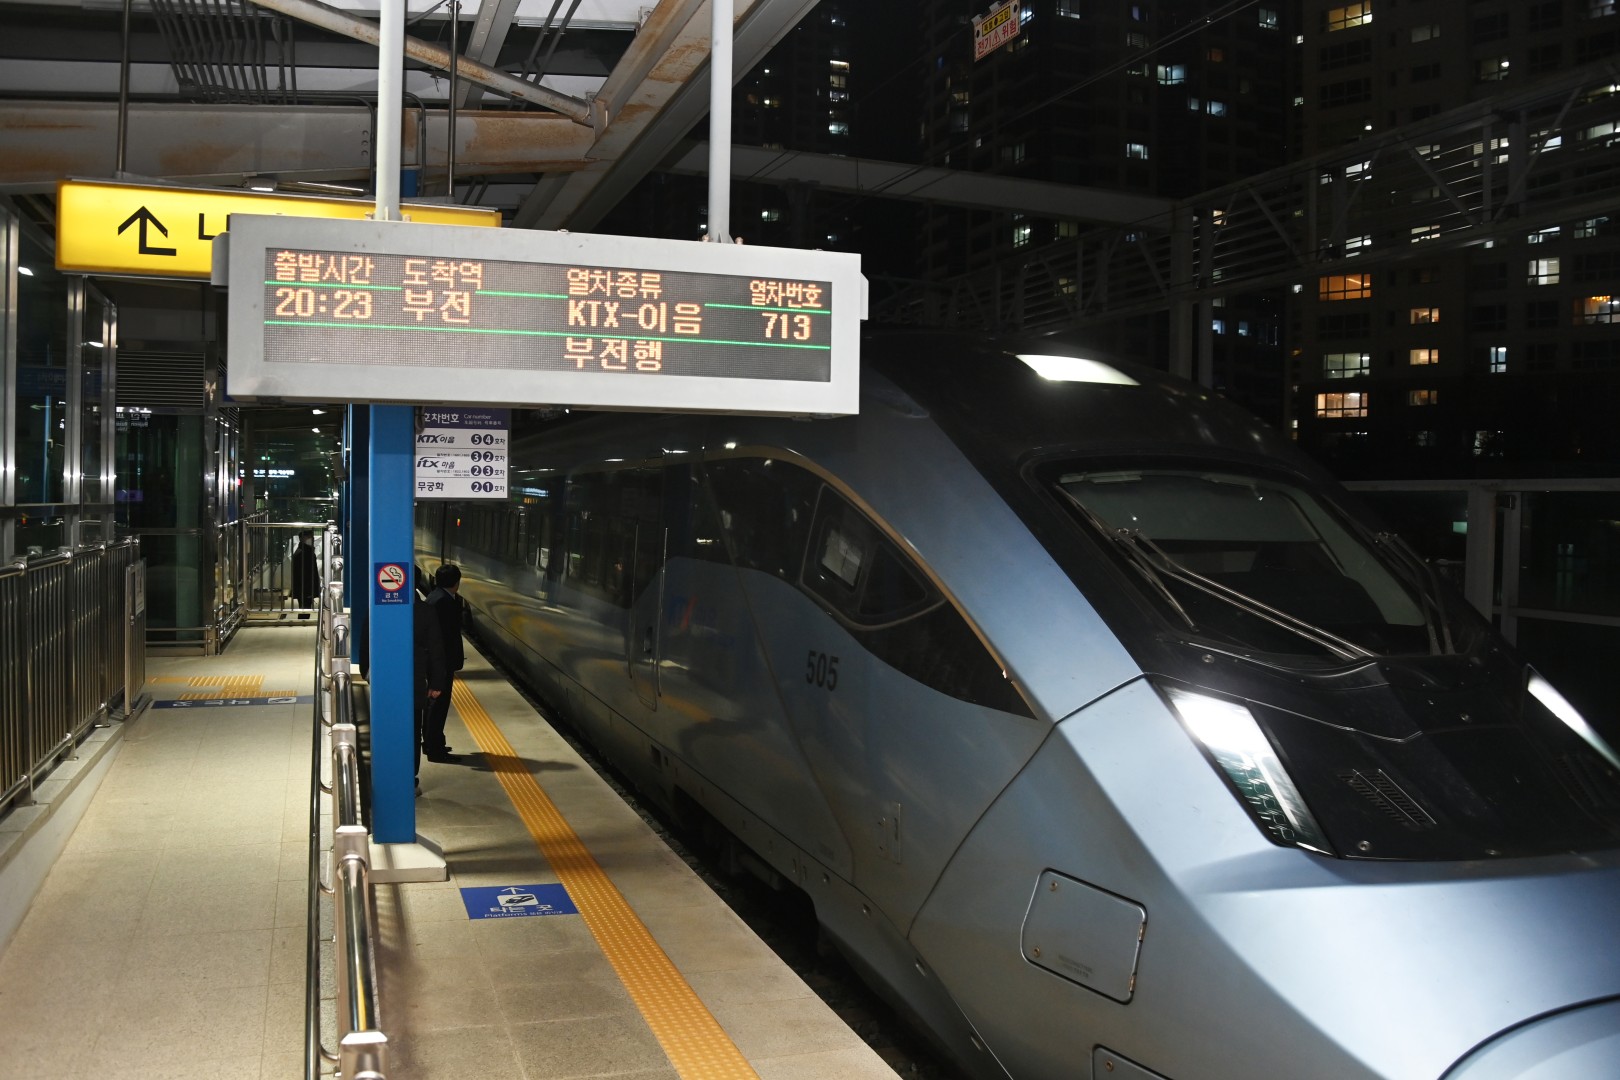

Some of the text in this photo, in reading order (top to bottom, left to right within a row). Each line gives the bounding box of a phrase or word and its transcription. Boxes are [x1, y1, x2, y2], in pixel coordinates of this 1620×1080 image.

[977, 18, 1017, 55] 전기 위험
[274, 251, 822, 308] 출발시간 도착역 열차종류 열차번호
[275, 287, 811, 340] 20:23 부전 KTX-이음 713
[564, 337, 662, 371] 부전행
[442, 461, 455, 469] 마음
[418, 481, 444, 492] 무궁화
[806, 650, 839, 691] 505
